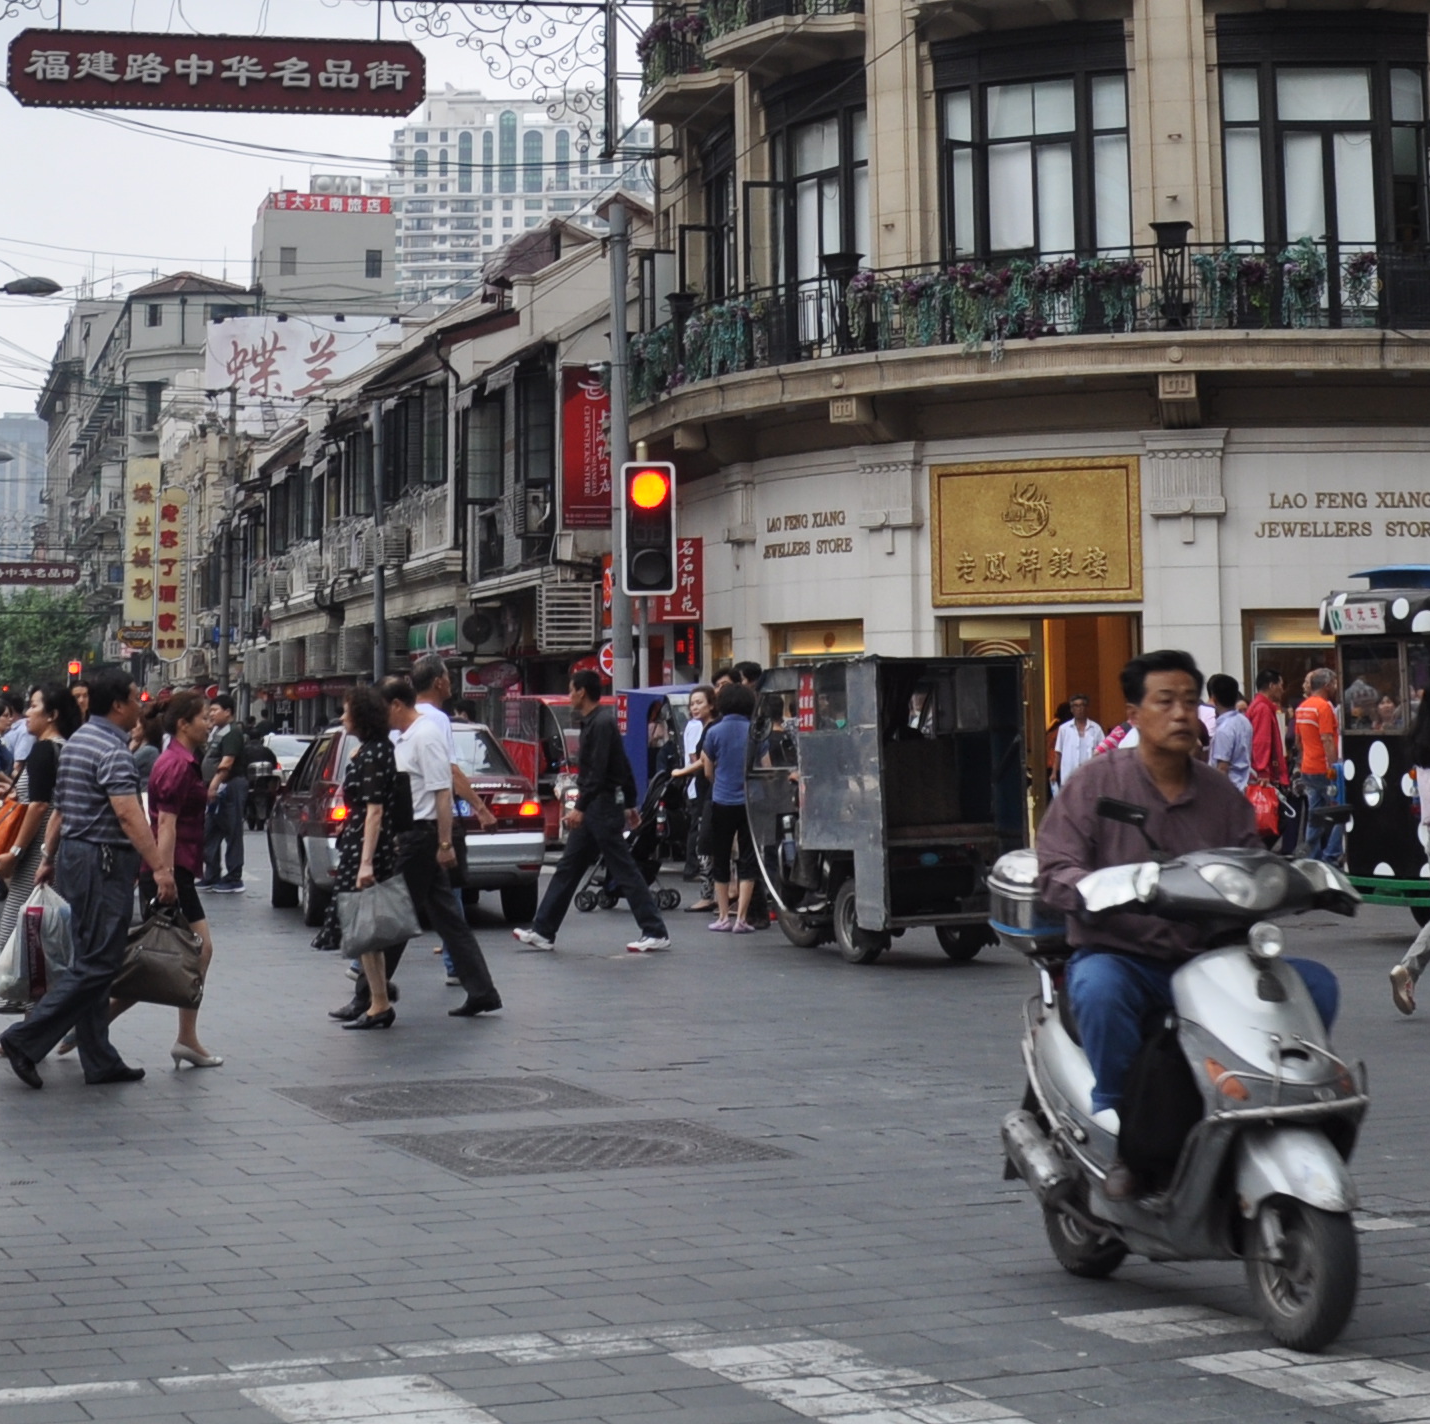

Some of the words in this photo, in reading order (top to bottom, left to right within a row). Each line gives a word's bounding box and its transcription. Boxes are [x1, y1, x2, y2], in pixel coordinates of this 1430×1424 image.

[24, 49, 412, 91] 福建路中华名品街
[290, 195, 382, 214] 大江南旅店
[225, 331, 340, 399] 蝶兰
[1268, 492, 1308, 509] LAO
[1314, 492, 1368, 509] FENG
[766, 517, 782, 533] LAO
[783, 514, 809, 531] FENG
[812, 510, 846, 529] XIANG
[1254, 521, 1373, 538] JEWELLERS
[763, 540, 811, 560] JEWELLERS
[815, 537, 853, 555] STORE
[956, 546, 1109, 585] 老鳳祥銀樓
